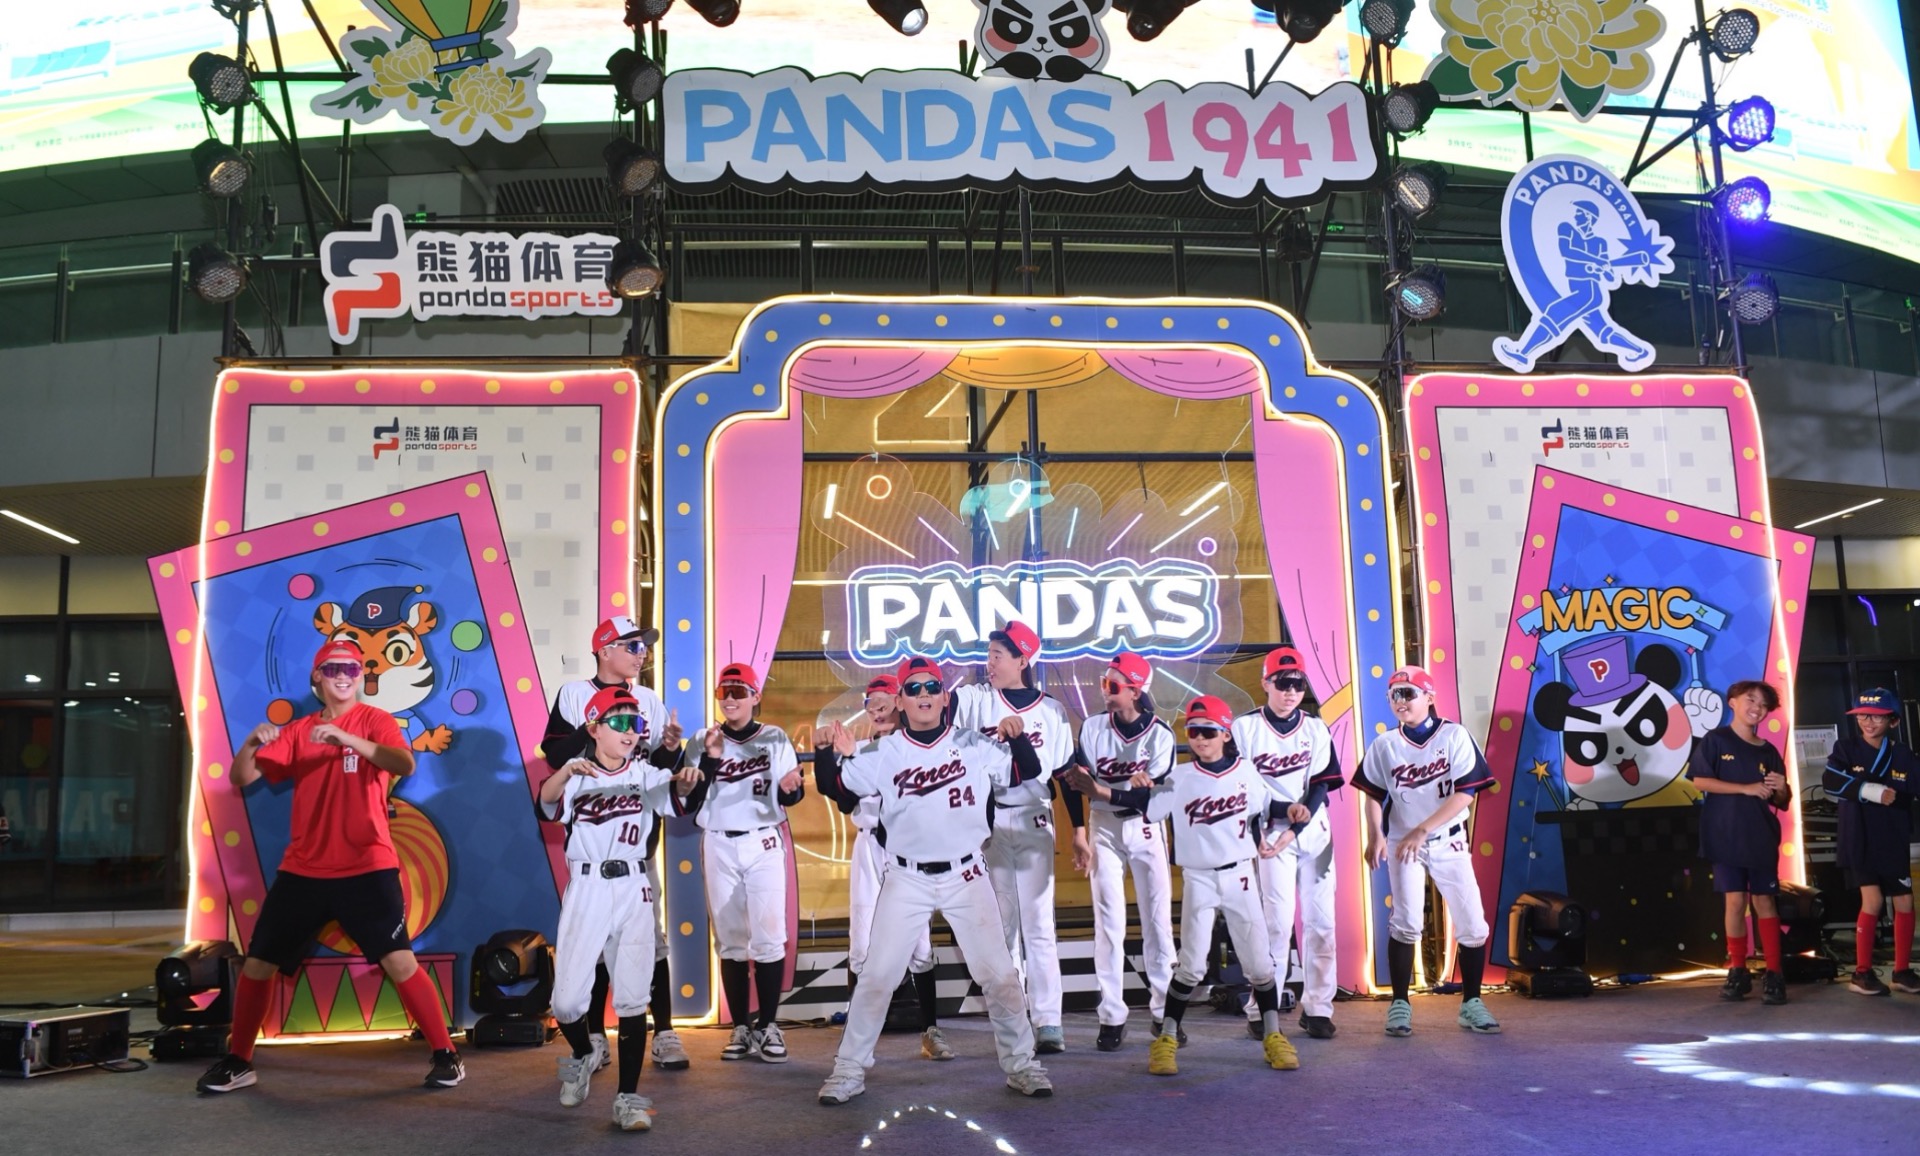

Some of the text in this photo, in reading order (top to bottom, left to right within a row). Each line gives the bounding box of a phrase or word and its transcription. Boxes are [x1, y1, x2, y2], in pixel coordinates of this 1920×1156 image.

[684, 86, 1358, 179] PANDAS 1941
[1514, 165, 1615, 206] PANDAS
[1614, 198, 1636, 227] 1941
[416, 241, 614, 283] 熊猫体育
[419, 286, 614, 313] pandasports
[405, 426, 478, 441] 熊猫体育
[1567, 426, 1629, 441] 熊猫体育
[405, 442, 477, 452] pandasports
[367, 603, 382, 619] P
[866, 578, 1205, 647] PANDAS
[1540, 586, 1695, 632] MAGIC
[1588, 658, 1610, 682] P
[713, 754, 771, 784] Korea
[1096, 757, 1150, 784] Korea
[1252, 750, 1312, 778] Korea
[1391, 758, 1451, 789] Korea
[752, 778, 772, 796] 27
[893, 759, 967, 799] Korea
[1437, 779, 1453, 799] 17
[948, 785, 975, 809] 24
[573, 793, 643, 826] Korea
[1033, 814, 1047, 829] 13
[1184, 793, 1248, 827] Korea
[618, 821, 640, 846] 10
[1142, 826, 1153, 840] 5
[1238, 820, 1247, 839] 7
[761, 836, 777, 851] 27
[1450, 841, 1464, 853] 17
[961, 863, 983, 882] 24
[1239, 876, 1249, 891] 7
